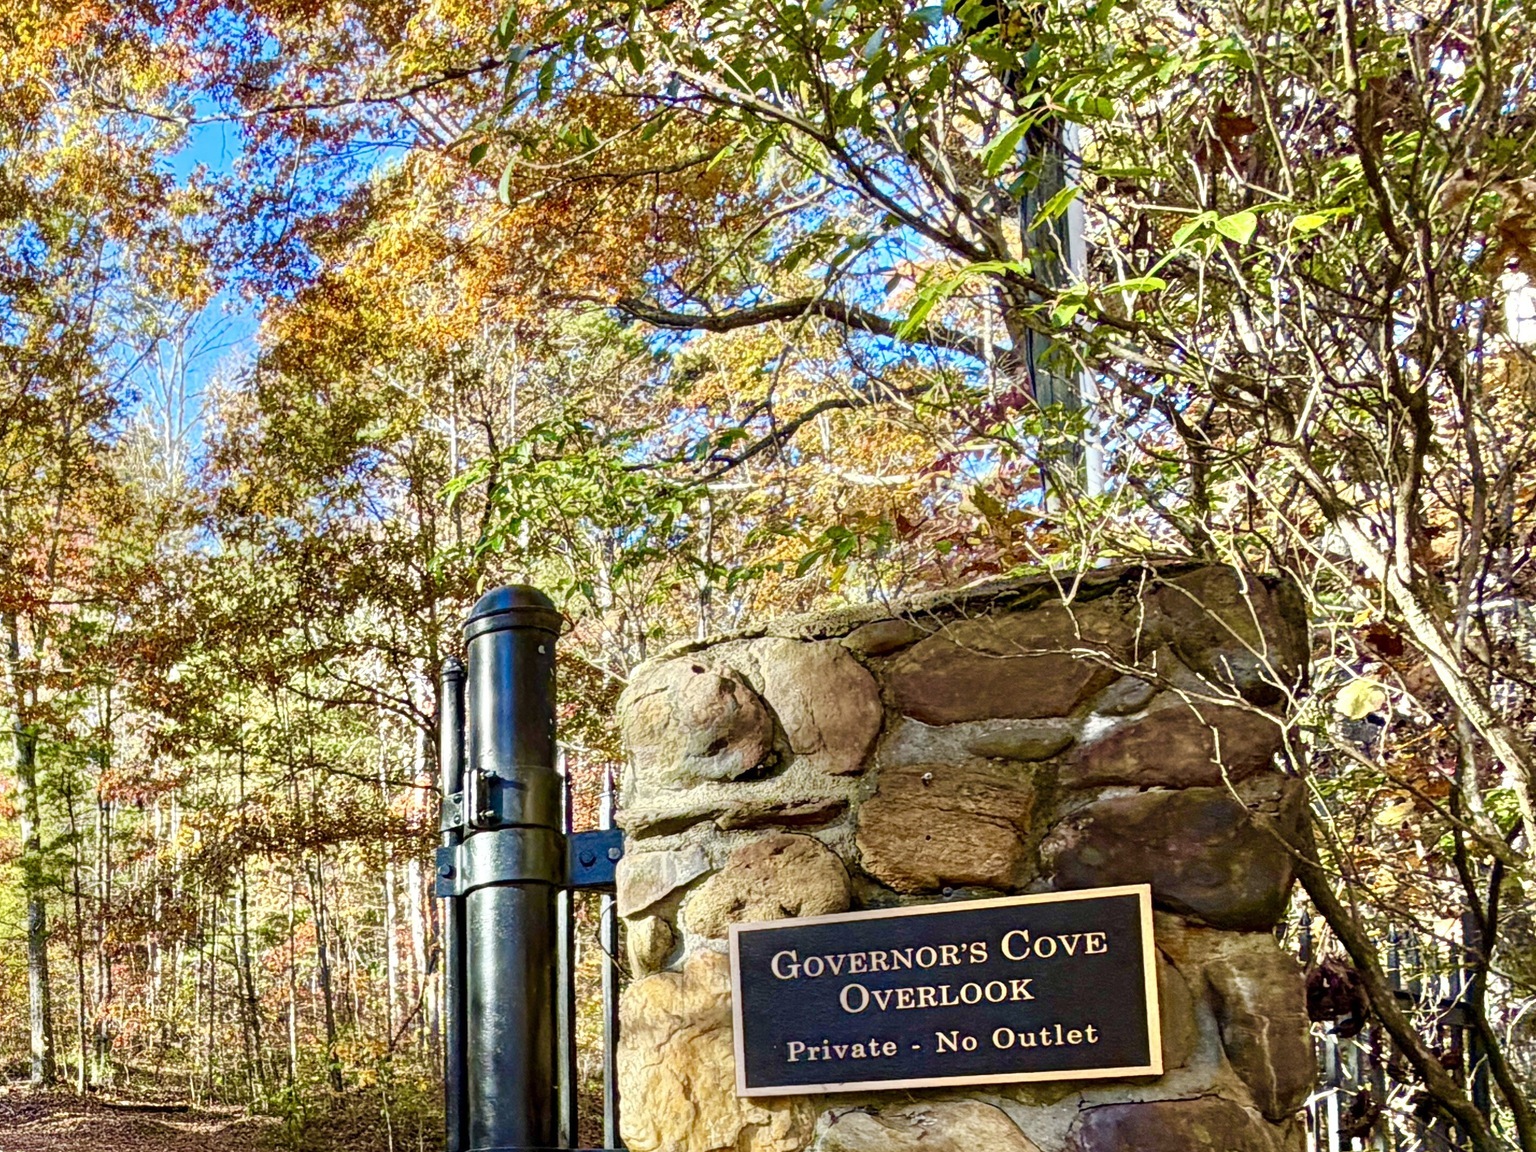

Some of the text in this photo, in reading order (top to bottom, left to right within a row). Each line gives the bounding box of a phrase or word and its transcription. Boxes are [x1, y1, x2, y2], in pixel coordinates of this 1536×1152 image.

[1000, 928, 1108, 962] COVE
[839, 977, 1035, 1014] OVERLOOK
[786, 1036, 898, 1063] Private
[935, 1030, 978, 1054] No
[992, 1022, 1099, 1051] Outlet
